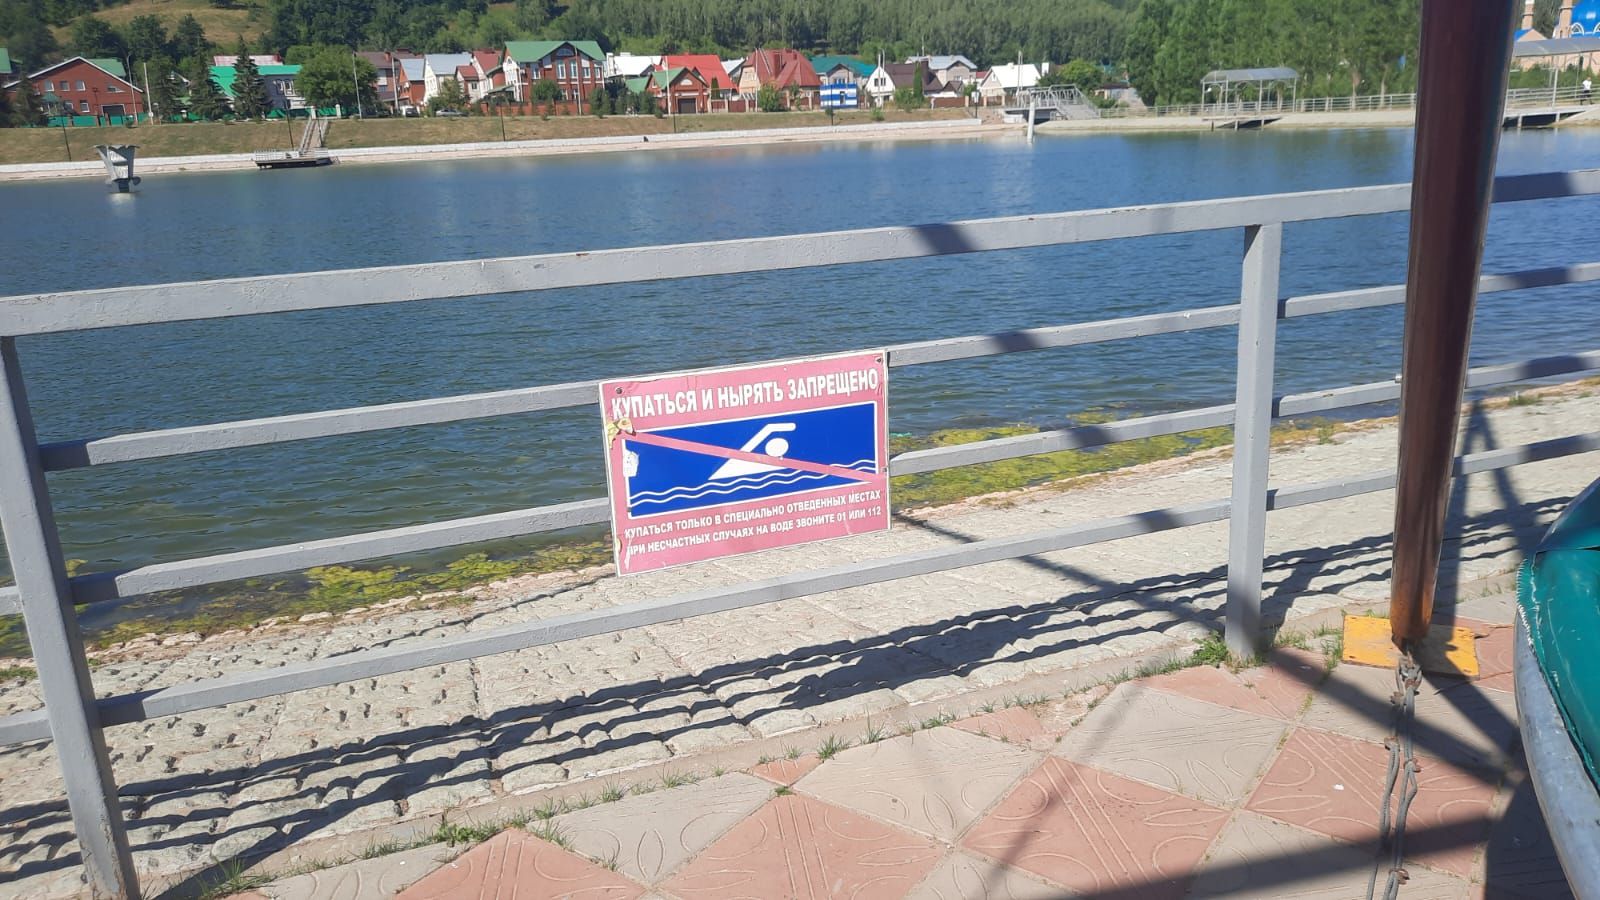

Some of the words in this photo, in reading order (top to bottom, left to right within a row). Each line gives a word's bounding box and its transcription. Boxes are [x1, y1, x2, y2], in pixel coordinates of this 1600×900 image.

[611, 390, 698, 420] КУПАТЬСЯ
[701, 388, 714, 411] И
[717, 381, 784, 409] НЫРЯТЬ
[787, 368, 878, 400] ЗАПРЕЩЕНО
[624, 522, 673, 539] КУПАТЬСЯ
[675, 516, 712, 530] ТОЛЬКО
[714, 514, 721, 525] В
[723, 505, 785, 524] СПЕЦИАЛЬНО
[786, 495, 847, 514] ОТВЕДЕННЫХ
[848, 489, 881, 504] МЕСТАХ
[627, 544, 646, 556] ПРИ
[647, 533, 711, 553] НЕСЧАСТНЫХ
[712, 526, 754, 542] СЛУЧАЯХ
[756, 524, 769, 535] НА
[770, 519, 794, 533] ВОДЕ
[796, 512, 835, 528] ЗВОНИТЕ
[836, 511, 847, 522] 01
[848, 508, 866, 521] ИЛИ
[867, 505, 881, 516] 112
